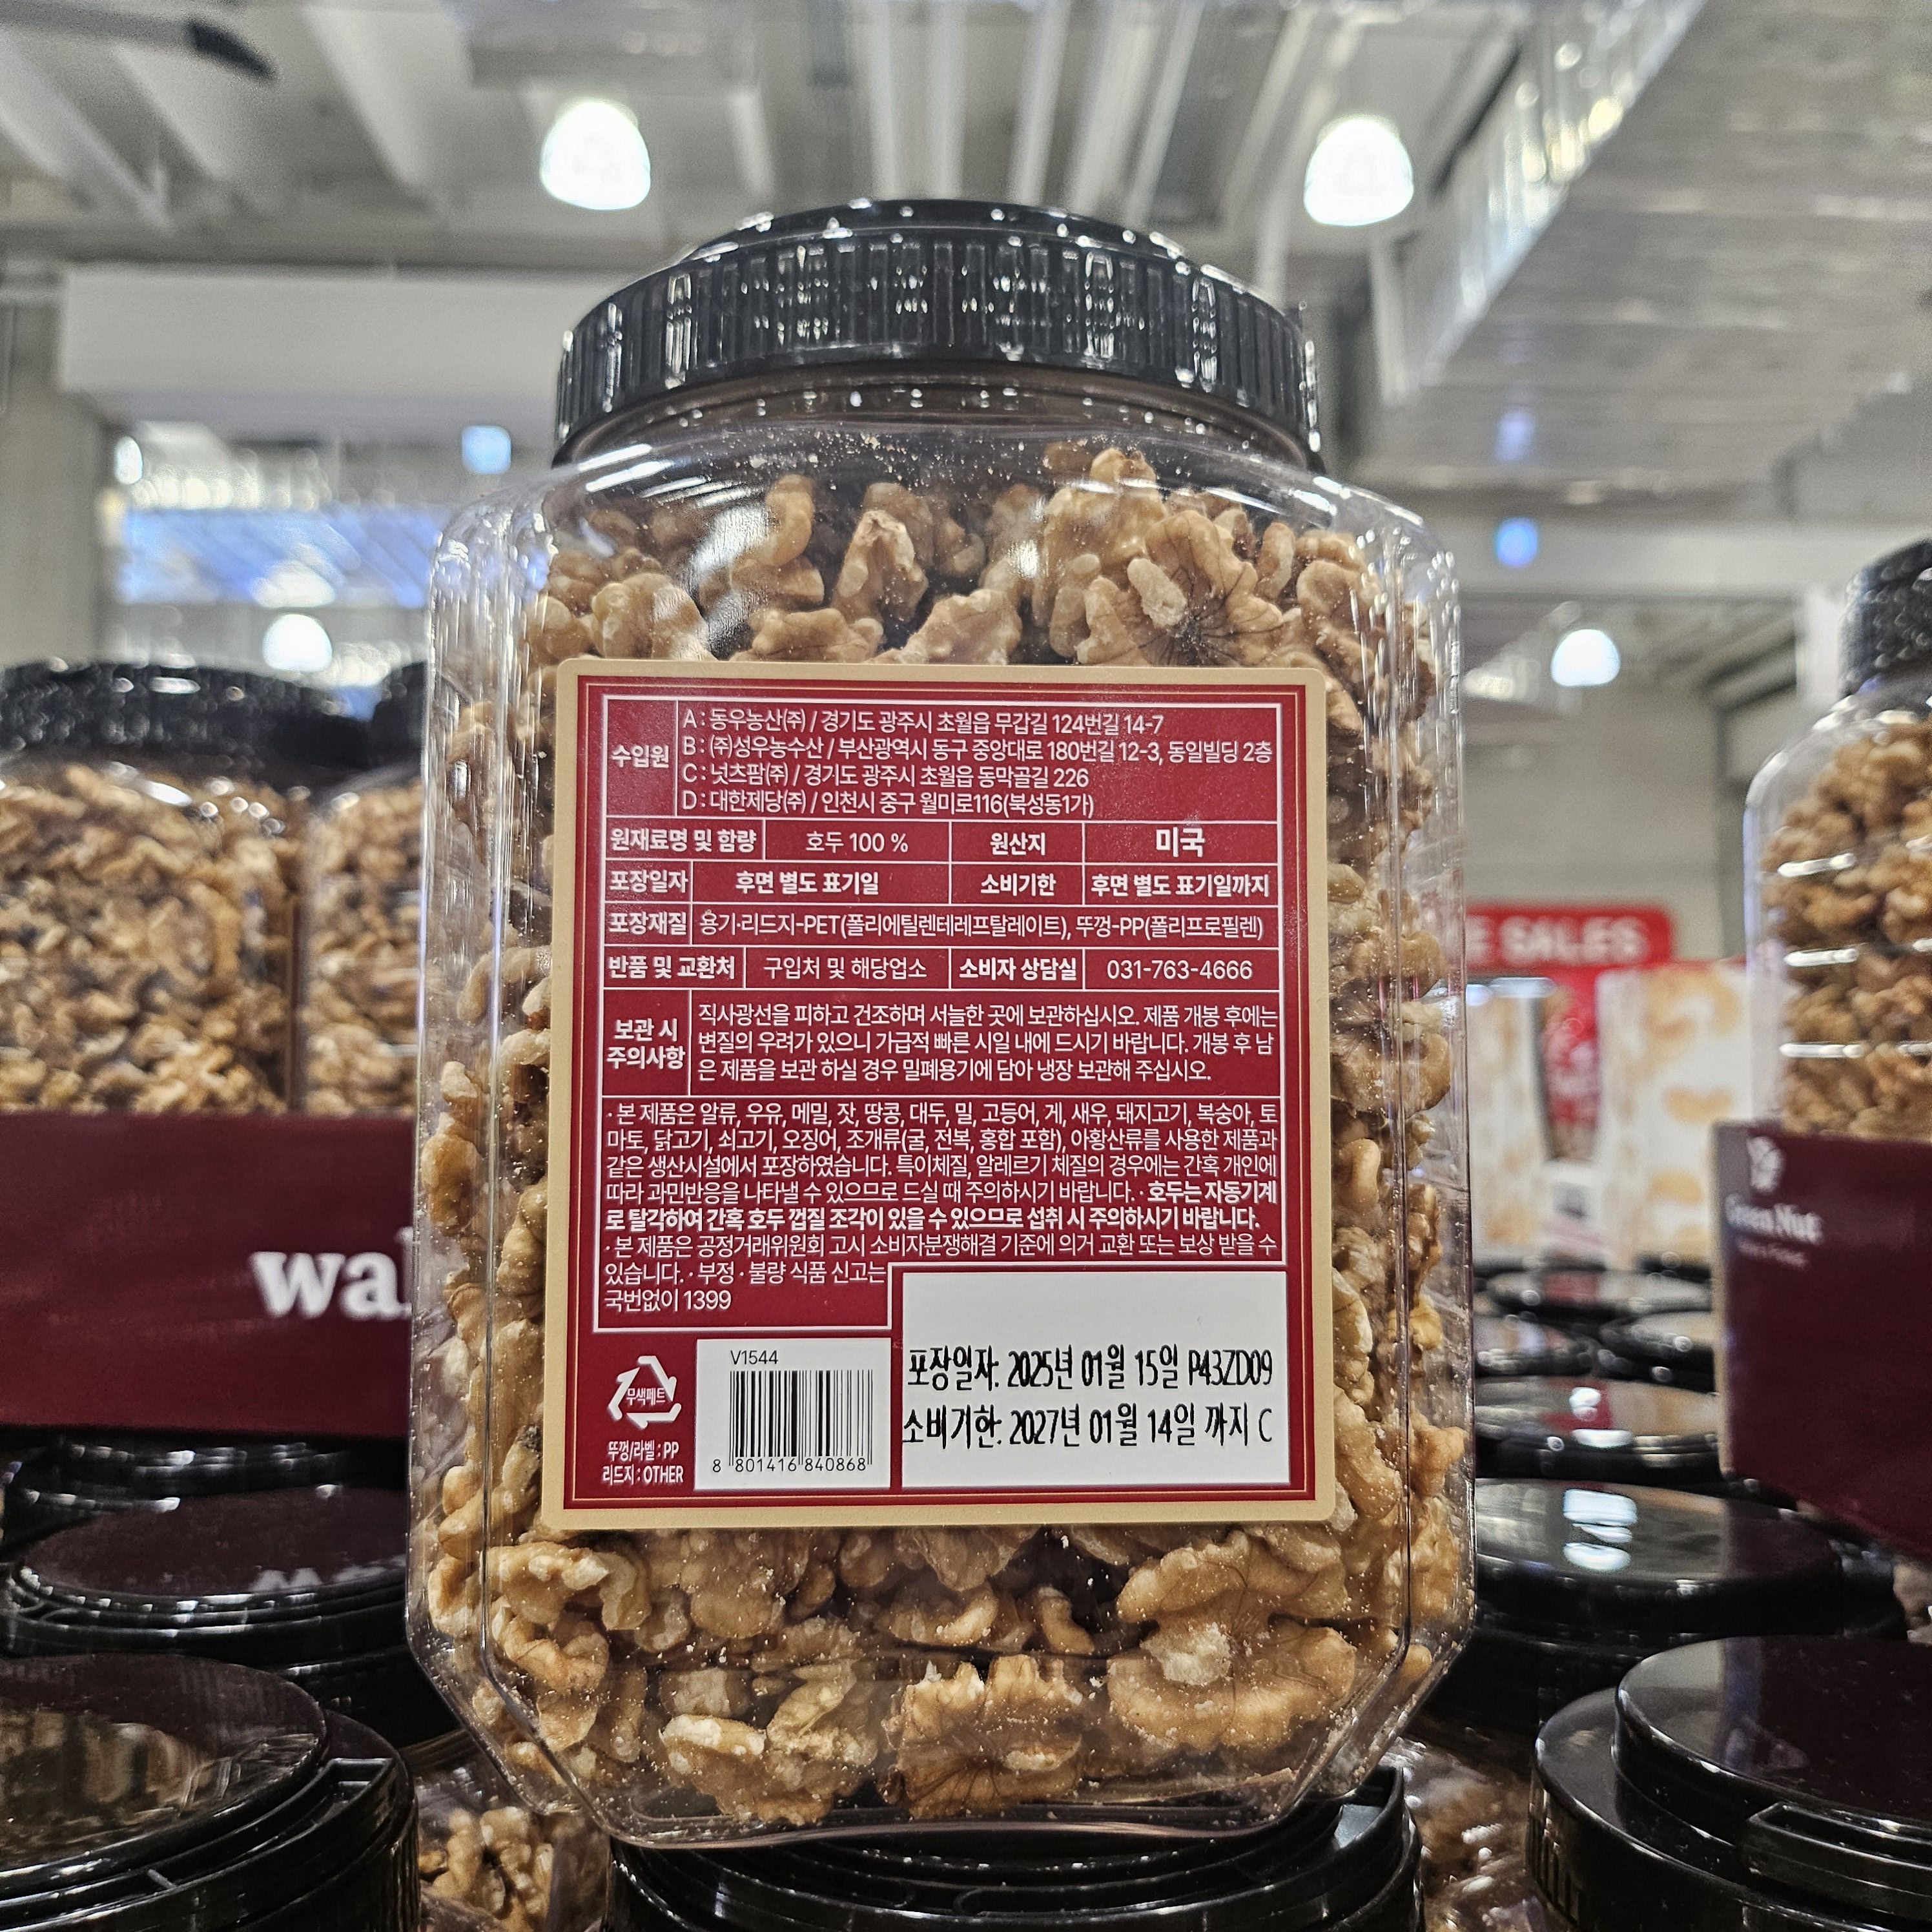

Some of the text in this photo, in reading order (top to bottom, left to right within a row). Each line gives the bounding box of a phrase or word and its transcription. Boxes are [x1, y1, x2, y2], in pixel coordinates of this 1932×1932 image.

[821, 710, 876, 733] 경기도
[879, 710, 932, 734] 광주시
[936, 712, 991, 734] 초월읍
[994, 712, 1047, 735] 무갑길
[1052, 712, 1120, 736] 124번길
[1124, 714, 1164, 734] 14-7
[611, 745, 669, 768] 수입원
[838, 737, 927, 761] 부산광역시
[932, 739, 969, 761] 동구
[972, 739, 1043, 762] 중앙대로
[1047, 739, 1115, 763] 180번길
[1118, 741, 1163, 766] 12-3,
[1167, 740, 1238, 763] 동일빌딩
[1243, 741, 1273, 763] 2층
[804, 763, 859, 786] 경기도
[861, 764, 915, 787] 광주시
[920, 765, 974, 788] 초월읍
[978, 765, 1049, 789] 동막골길
[1053, 768, 1089, 788] 226
[821, 790, 875, 814] 인천시
[879, 792, 916, 814] 중구
[610, 827, 757, 853] 원재료명 및 함량
[806, 830, 844, 853] 호두
[990, 832, 1045, 856] 원산지
[1156, 827, 1206, 858] 미국
[609, 869, 689, 893] 포장일자
[735, 870, 879, 895] 후면 별도 표기일
[980, 873, 1056, 896] 소비기한
[1091, 874, 1269, 898] 후면 별도 표기일까지
[609, 911, 686, 936] 포장재질
[608, 955, 735, 980] 반품 및 교환처
[763, 956, 927, 980] 구입처 및 해당업소
[959, 957, 1076, 981] 소비자 상담실
[1107, 960, 1253, 980] 031-763-4666
[699, 1003, 1279, 1028] 직사광선을 피하고 건조하며 서늘한 곳에 보관하십시오. 제품 개봉 후에는
[614, 1018, 677, 1042] 보관 시
[699, 1031, 753, 1054] 변질의
[757, 1031, 814, 1054] 우려가
[817, 1031, 870, 1054] 있으니
[876, 1031, 929, 1054] 가급적
[934, 1031, 971, 1054] 빠른
[974, 1031, 1010, 1054] 시일
[1015, 1031, 1050, 1054] 내에
[1054, 1031, 1107, 1054] 드시기
[1113, 1032, 1189, 1054] 바랍니다.
[1193, 1032, 1229, 1055] 개봉
[1233, 1032, 1251, 1055] 후
[606, 1045, 686, 1069] 주의사항
[617, 1103, 636, 1125] 본
[639, 1102, 696, 1125] 제품은
[700, 1102, 741, 1128] 알류,
[746, 1102, 786, 1128] 우유,
[792, 1102, 832, 1127] 메밀,
[837, 1102, 859, 1127] 잣,
[865, 1102, 905, 1127] 땅콩,
[910, 1102, 950, 1127] 대두,
[955, 1102, 977, 1127] 밀,
[981, 1102, 1040, 1127] 고등어,
[1045, 1102, 1067, 1127] 게,
[1071, 1102, 1111, 1127] 새우,
[1116, 1102, 1191, 1128] 돼지고기,
[1197, 1102, 1255, 1127] 복숭아,
[607, 1129, 648, 1155] 마토,
[654, 1128, 713, 1155] 닭고기,
[718, 1128, 777, 1154] 쇠고기,
[782, 1128, 841, 1154] 오징어,
[934, 1127, 974, 1154] 전복,
[979, 1127, 1016, 1151] 홍합
[1020, 1127, 1066, 1153] 포함),
[1071, 1127, 1161, 1151] 아황산류를
[1164, 1128, 1220, 1151] 사용한
[1223, 1128, 1278, 1151] 제품과
[628, 1208, 703, 1232] 탈각하여
[706, 1207, 745, 1231] 간혹
[747, 1208, 785, 1231] 호두
[788, 1207, 825, 1231] 껍질
[828, 1207, 883, 1231] 조각이
[888, 1206, 925, 1231] 있을
[928, 1207, 948, 1231] 수
[951, 1206, 1024, 1230] 있으므로
[1027, 1206, 1063, 1230] 섭취
[1067, 1206, 1085, 1230] 시
[1089, 1206, 1178, 1230] 주의하시기
[1182, 1206, 1260, 1230] 바랍니다.
[605, 1260, 887, 1285] 있습니다. 부정 불량 식품 신고는
[604, 1288, 732, 1313] 국번없이 1399
[730, 1350, 778, 1365] V1544
[1007, 1344, 1073, 1390] 2025년
[1081, 1344, 1125, 1390] 01월
[1134, 1343, 1178, 1390] 15일
[1188, 1349, 1273, 1386] P43ZD09
[625, 1387, 666, 1406] 무색페트
[1009, 1403, 1080, 1448] 2027년
[1089, 1403, 1137, 1446] 01월
[1147, 1402, 1195, 1446] 14일
[1204, 1402, 1248, 1446] 까지
[1258, 1408, 1272, 1443] C
[663, 1441, 679, 1459] PP
[643, 1465, 684, 1485] OTHER
[735, 1458, 797, 1473] 801416
[805, 1457, 867, 1472] 840868
